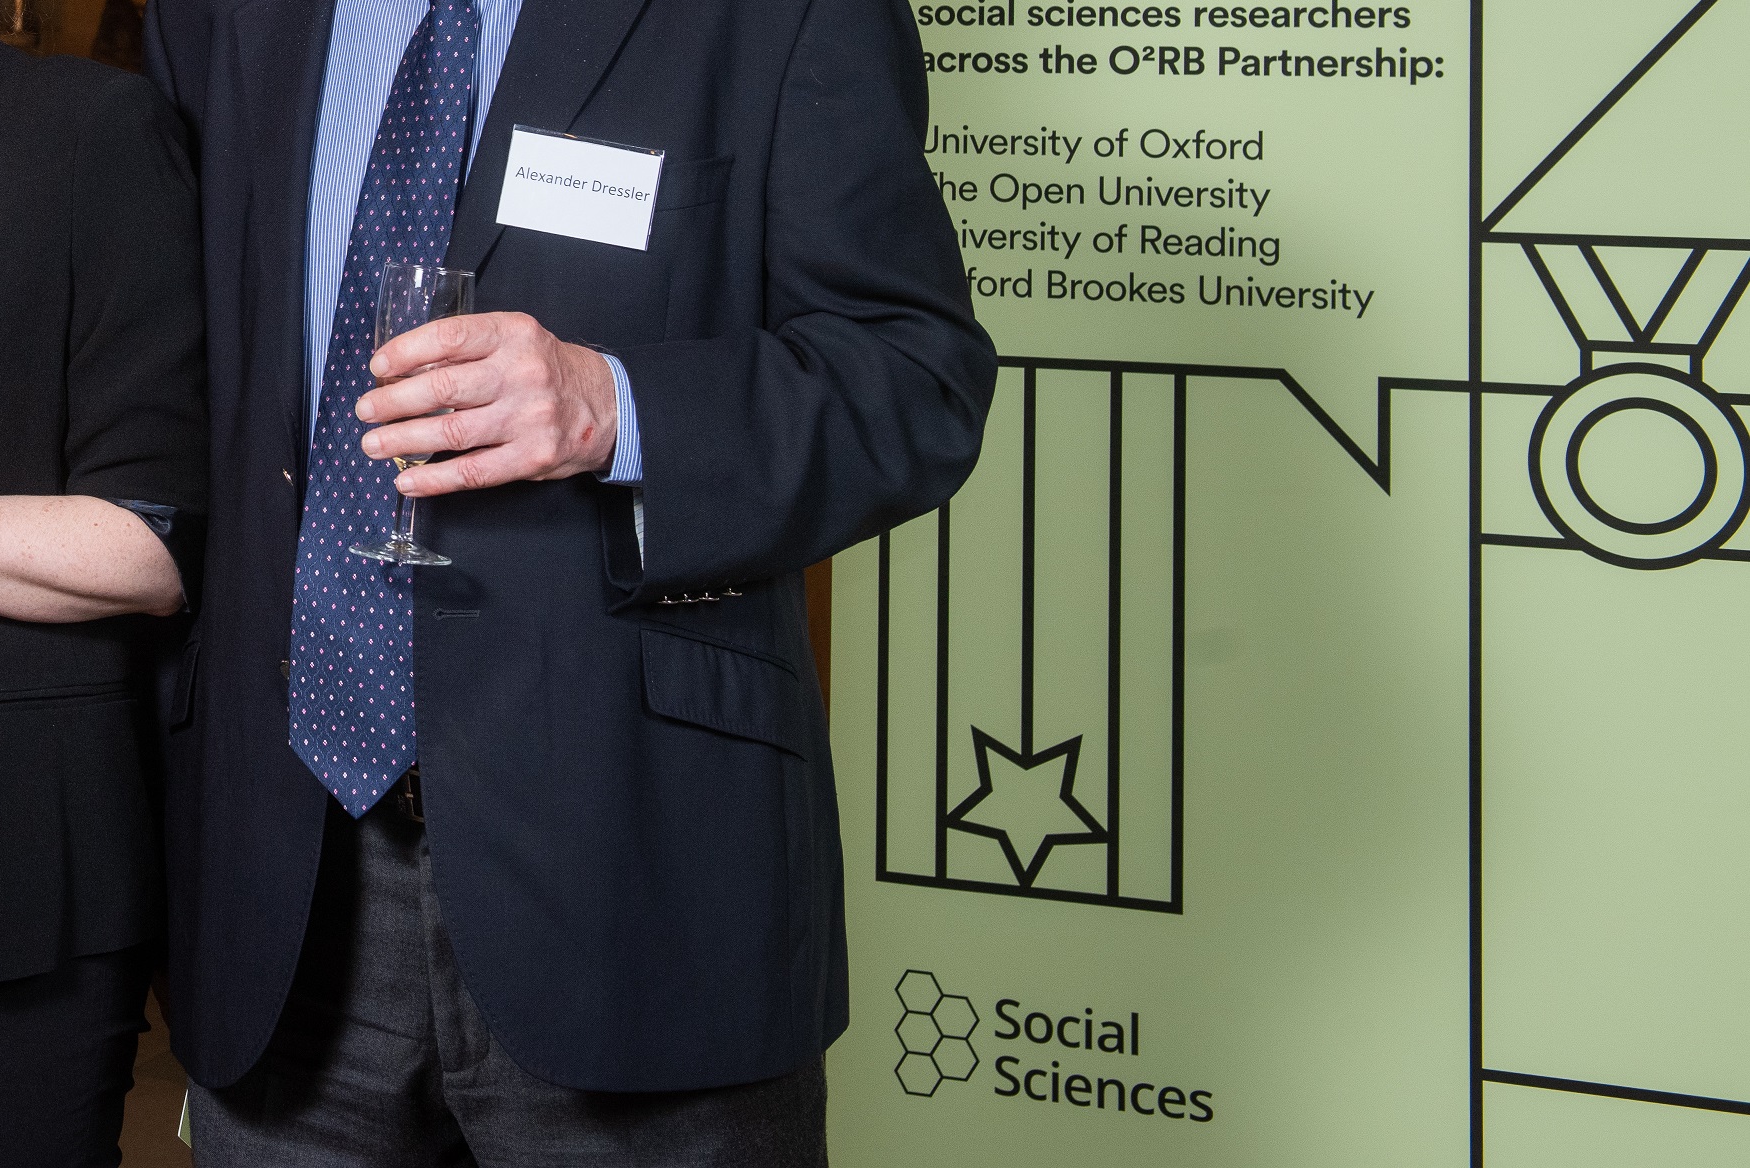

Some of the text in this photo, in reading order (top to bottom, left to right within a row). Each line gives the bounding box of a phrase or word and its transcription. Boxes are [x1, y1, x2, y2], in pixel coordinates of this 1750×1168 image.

[1193, 0, 1411, 28] researchers
[923, 47, 1028, 74] across
[1039, 46, 1097, 74] the
[1218, 47, 1444, 85] Partnership:
[1093, 129, 1128, 157] of
[1140, 129, 1264, 161] Oxford
[515, 166, 650, 202] Alexander Dressler
[990, 173, 1085, 211] Open
[1099, 177, 1270, 216] University
[961, 219, 1280, 265] iversity of Reading
[967, 267, 1374, 318] ford Brookes University
[994, 999, 1139, 1055] Social
[994, 1055, 1214, 1123] Sciences
